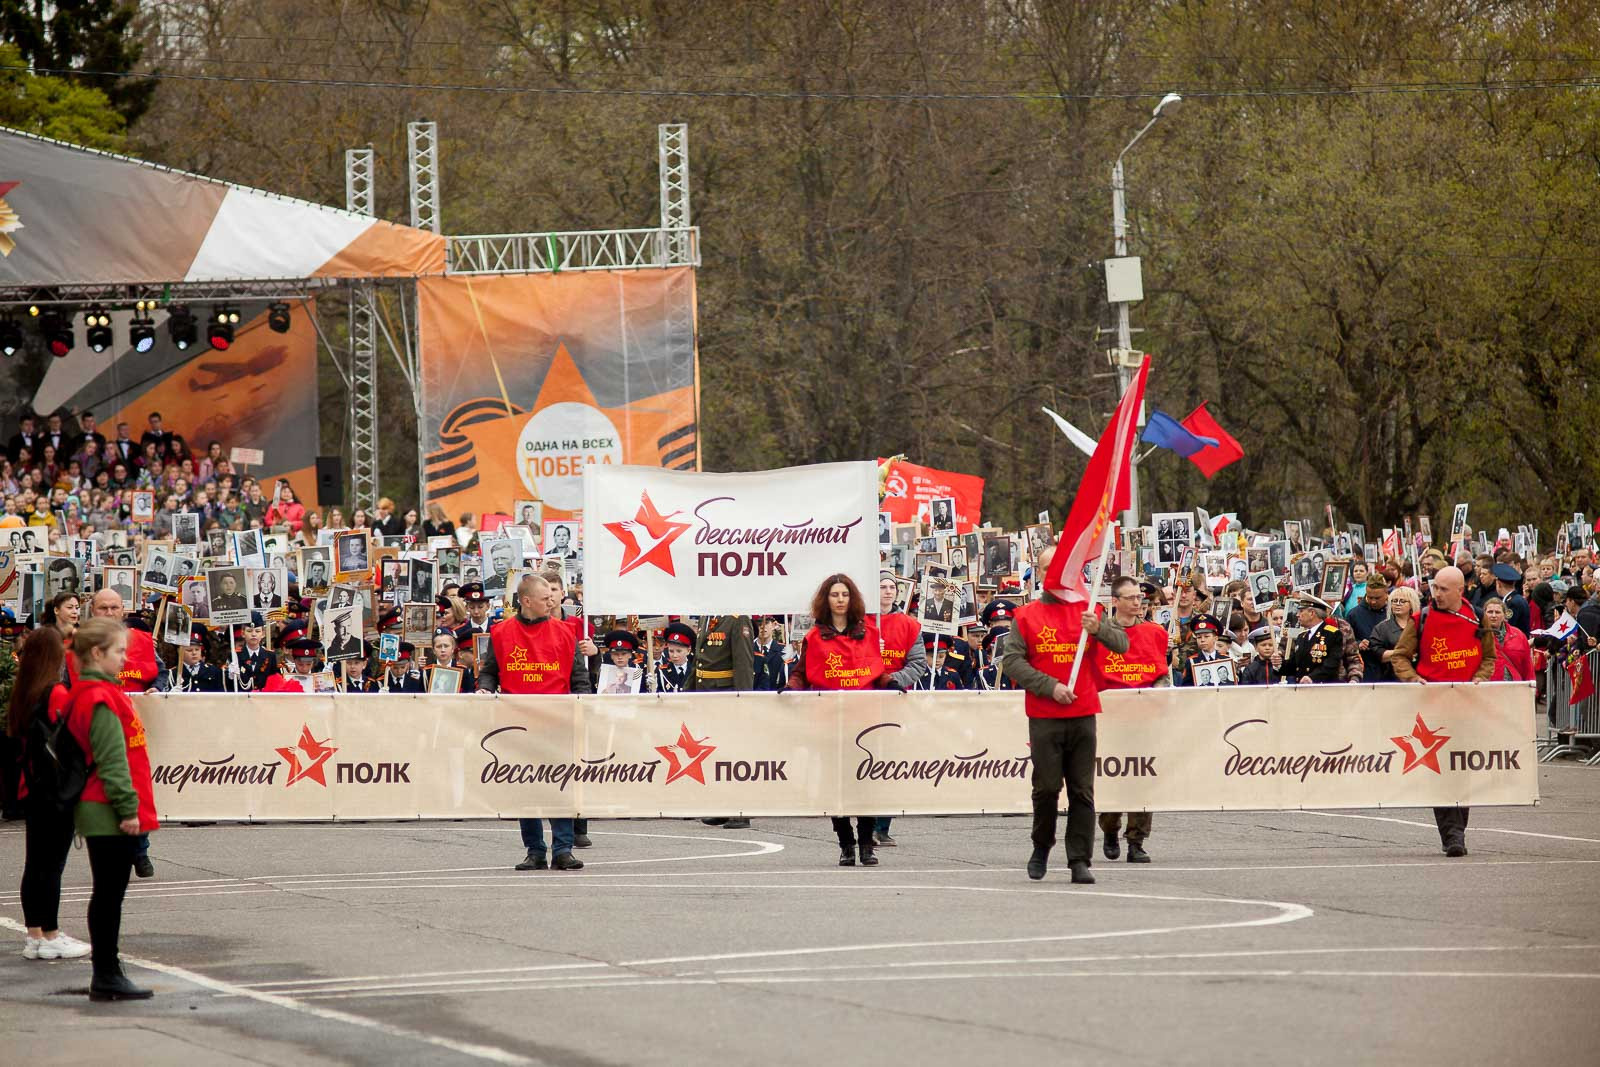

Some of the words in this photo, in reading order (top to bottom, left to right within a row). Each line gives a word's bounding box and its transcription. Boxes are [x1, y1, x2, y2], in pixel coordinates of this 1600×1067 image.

[525, 441, 558, 451] ОДНА
[562, 440, 578, 450] НА
[582, 438, 613, 449] ВСЕХ
[694, 496, 862, 551] бессмертный
[697, 551, 788, 577] ПОЛК
[1036, 643, 1089, 653] БЕССМЕРТН
[1430, 646, 1479, 662] БЕССМЕРТНЫЙ
[506, 661, 560, 671] БЕССМЕРТНЫЙ
[1104, 664, 1156, 673] БЕССМЕРТНЫЙ
[1447, 660, 1466, 669] ПОЛК
[523, 673, 543, 682] ПОЛК
[825, 667, 871, 678] БЕССМЕРТНЫЙ
[840, 678, 860, 687] ПОЛК
[855, 722, 1031, 787] бессмертный
[1223, 719, 1398, 783] бессмертный
[1450, 750, 1521, 771] ПОЛК
[480, 726, 661, 792] бессмертный
[715, 760, 788, 781] ПОЛК
[151, 754, 282, 793] мертный
[336, 763, 411, 784] ПОЛК
